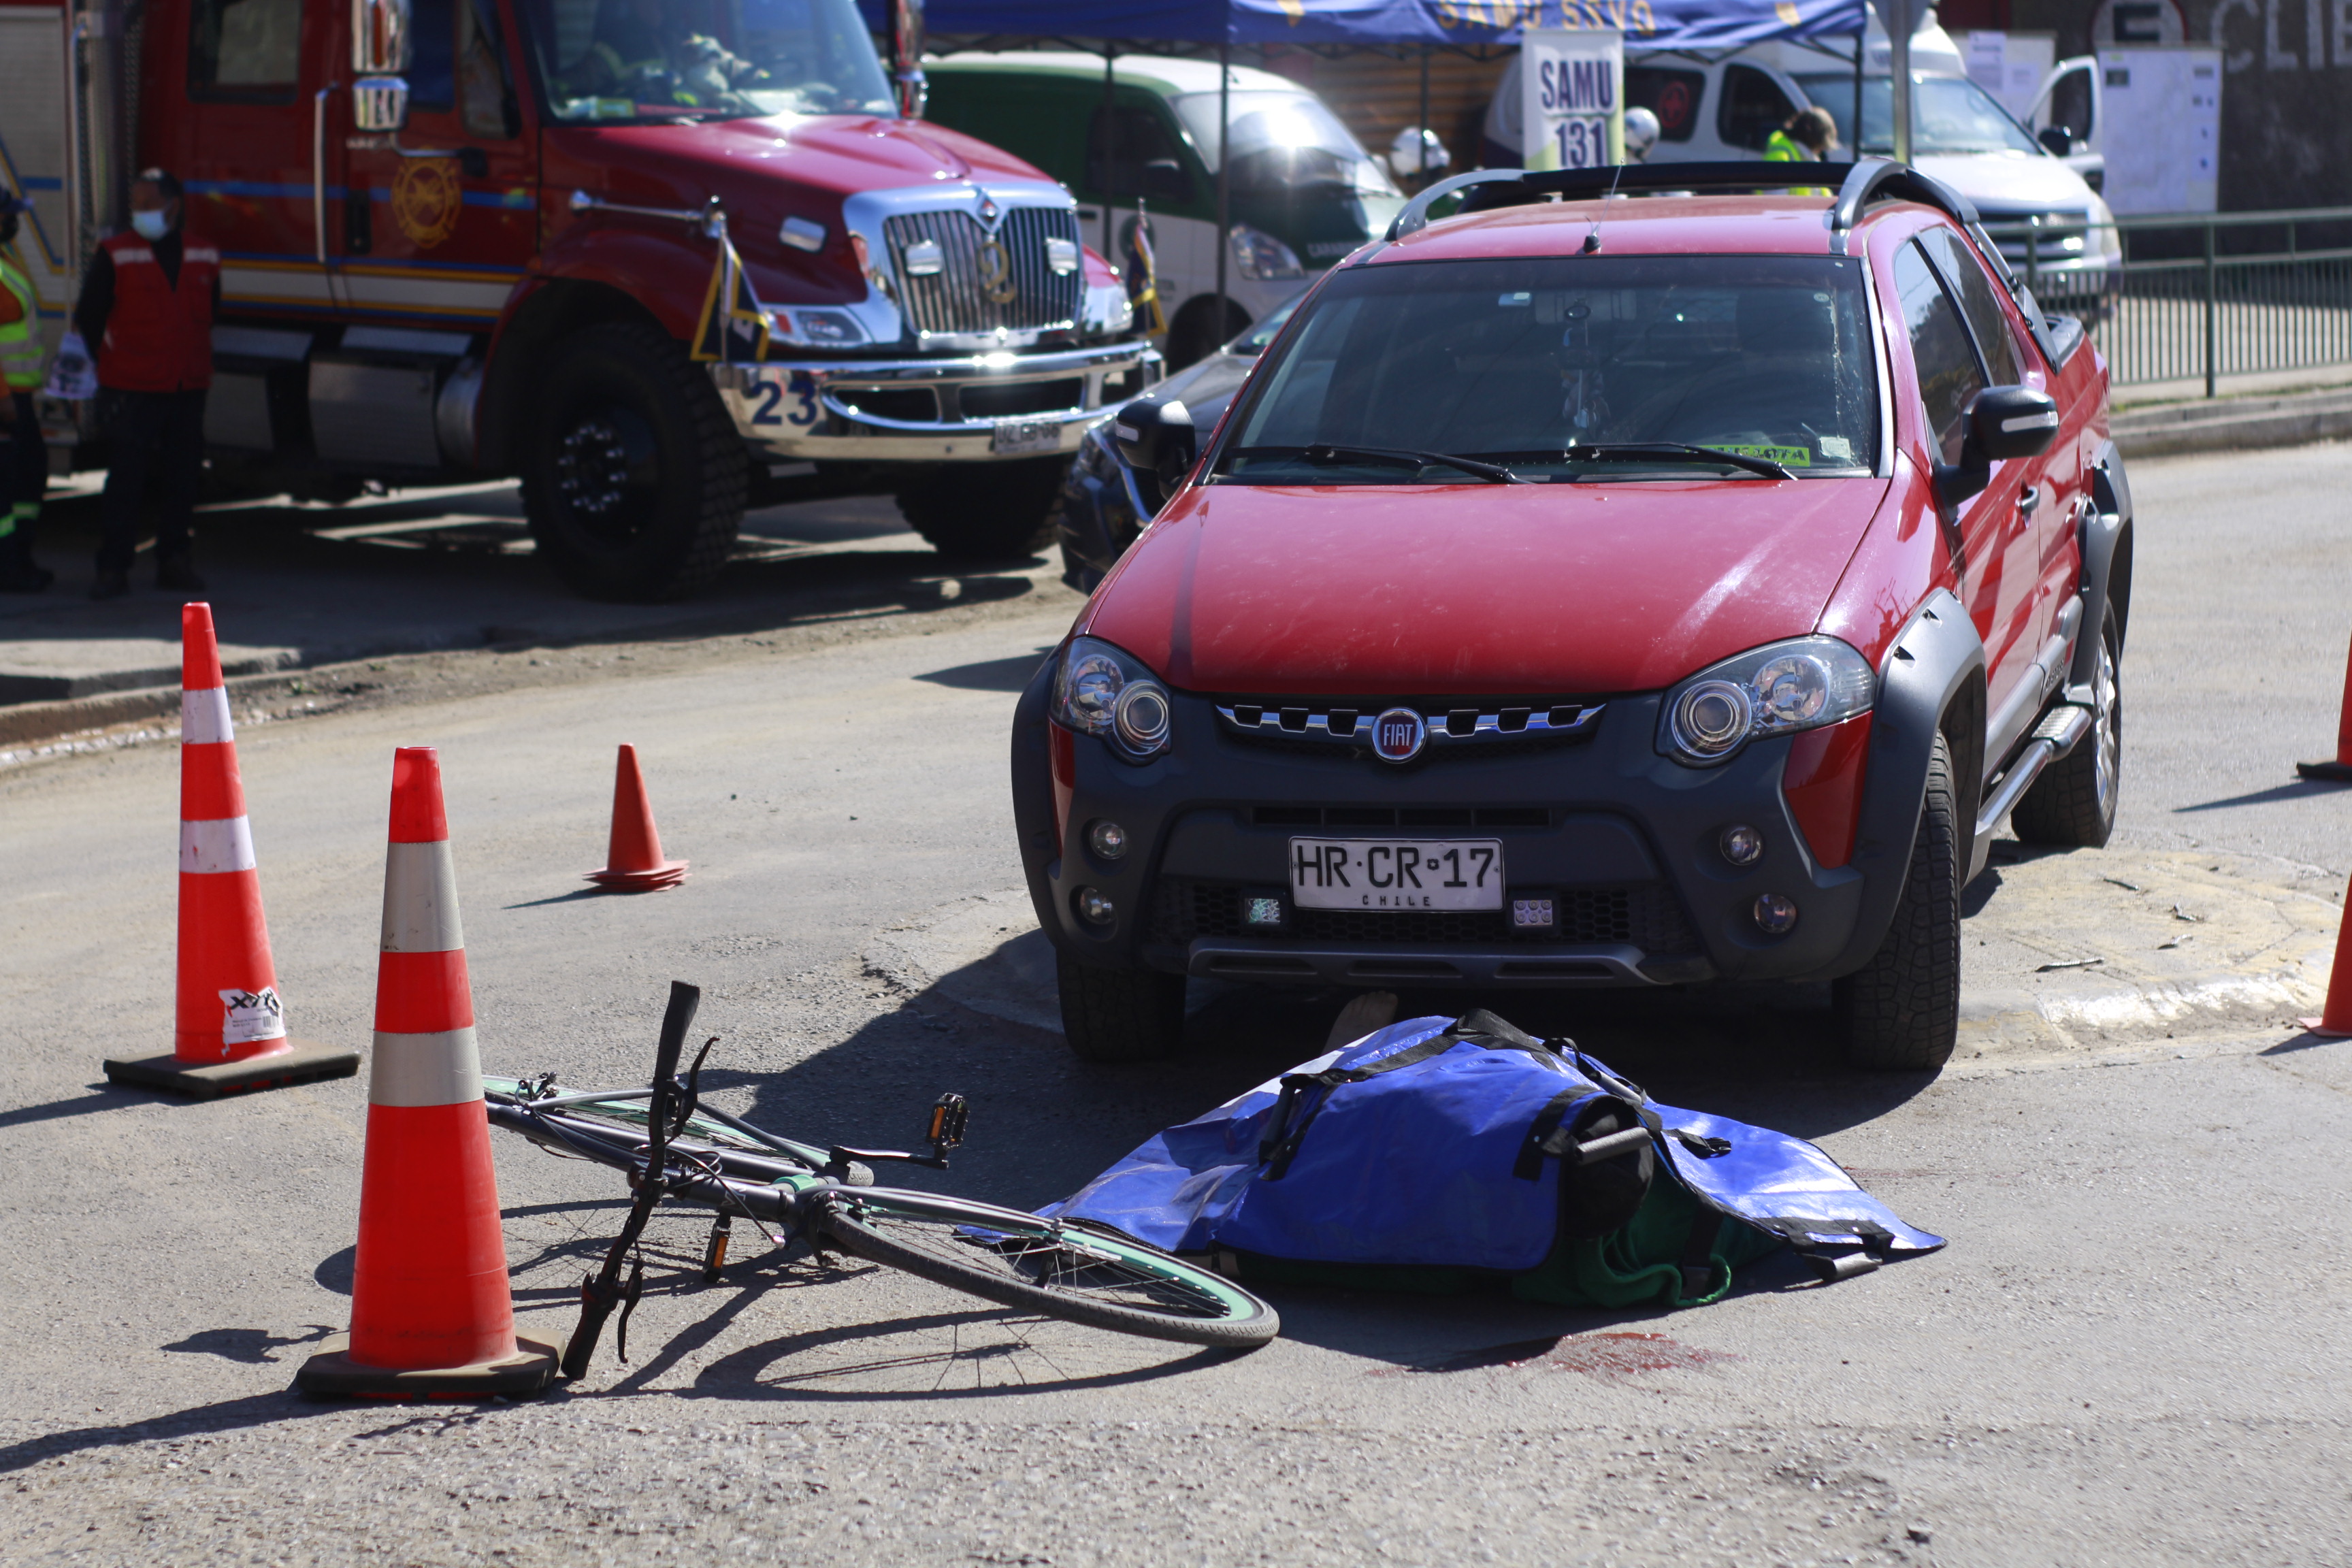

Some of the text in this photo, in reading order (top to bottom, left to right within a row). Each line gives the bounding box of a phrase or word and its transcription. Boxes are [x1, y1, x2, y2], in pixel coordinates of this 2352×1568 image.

[1437, 0, 1541, 29] SAMU
[1541, 60, 1613, 109] SAMU
[1556, 121, 1604, 167] 131
[751, 380, 817, 426] 23
[1384, 723, 1413, 747] FIAT
[1362, 895, 1431, 906] CHILE
